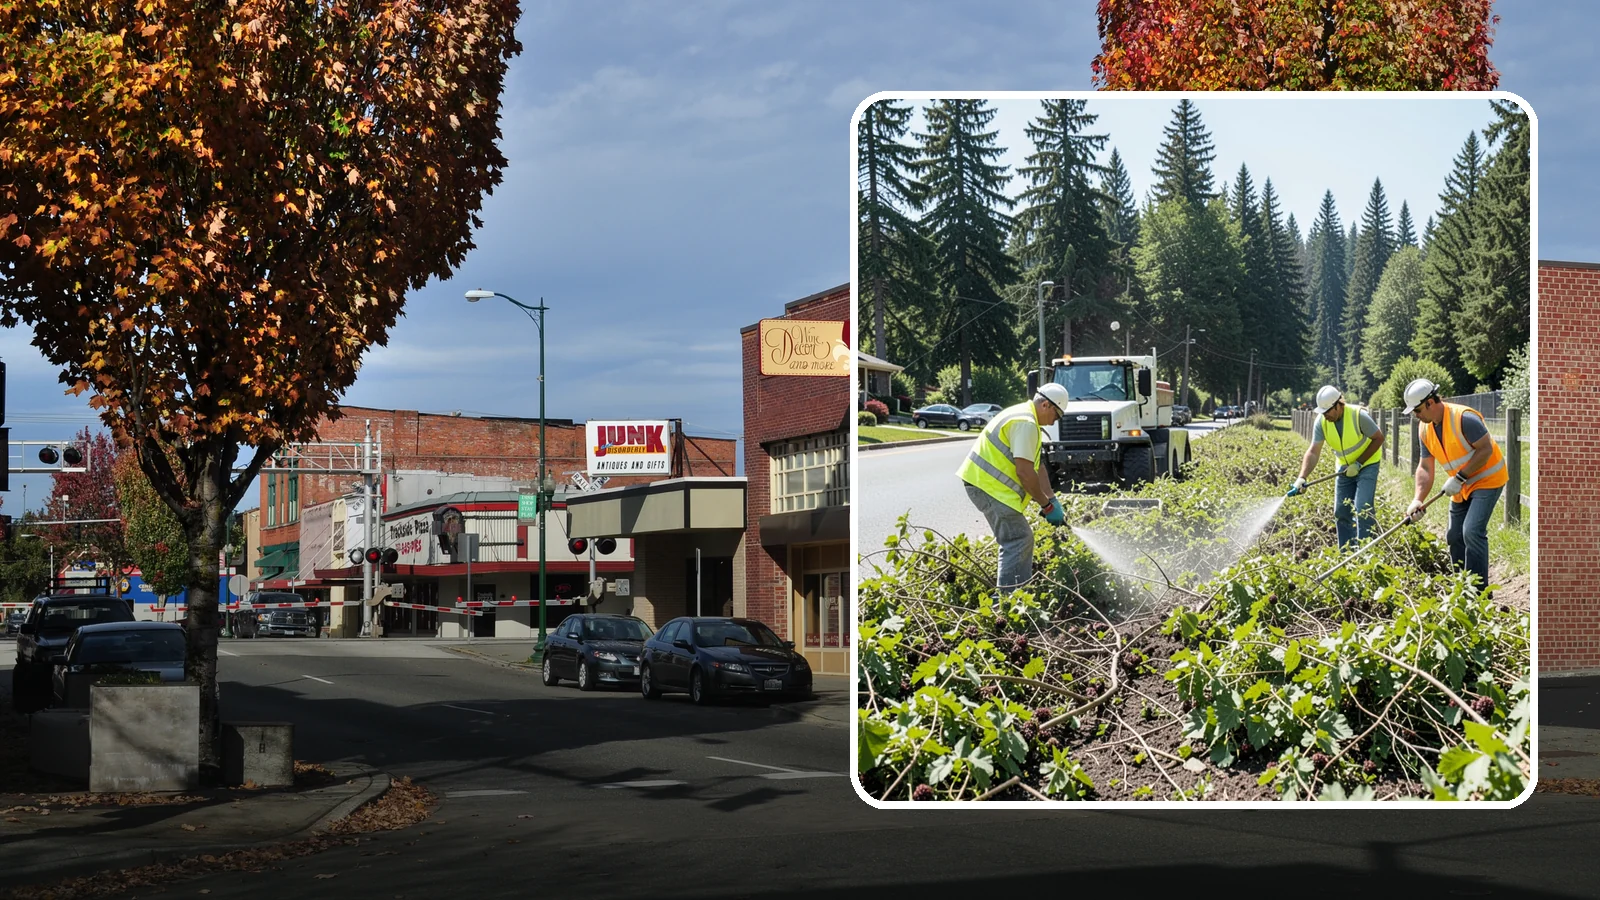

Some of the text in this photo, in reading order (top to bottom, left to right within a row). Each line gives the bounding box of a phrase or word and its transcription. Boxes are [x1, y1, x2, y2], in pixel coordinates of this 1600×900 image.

[596, 425, 665, 457] JUNK
[607, 446, 646, 454] DISORDERLY
[597, 460, 665, 470] ANTIQUES AND GIFTS
[390, 519, 429, 539] Trackside Pizza
